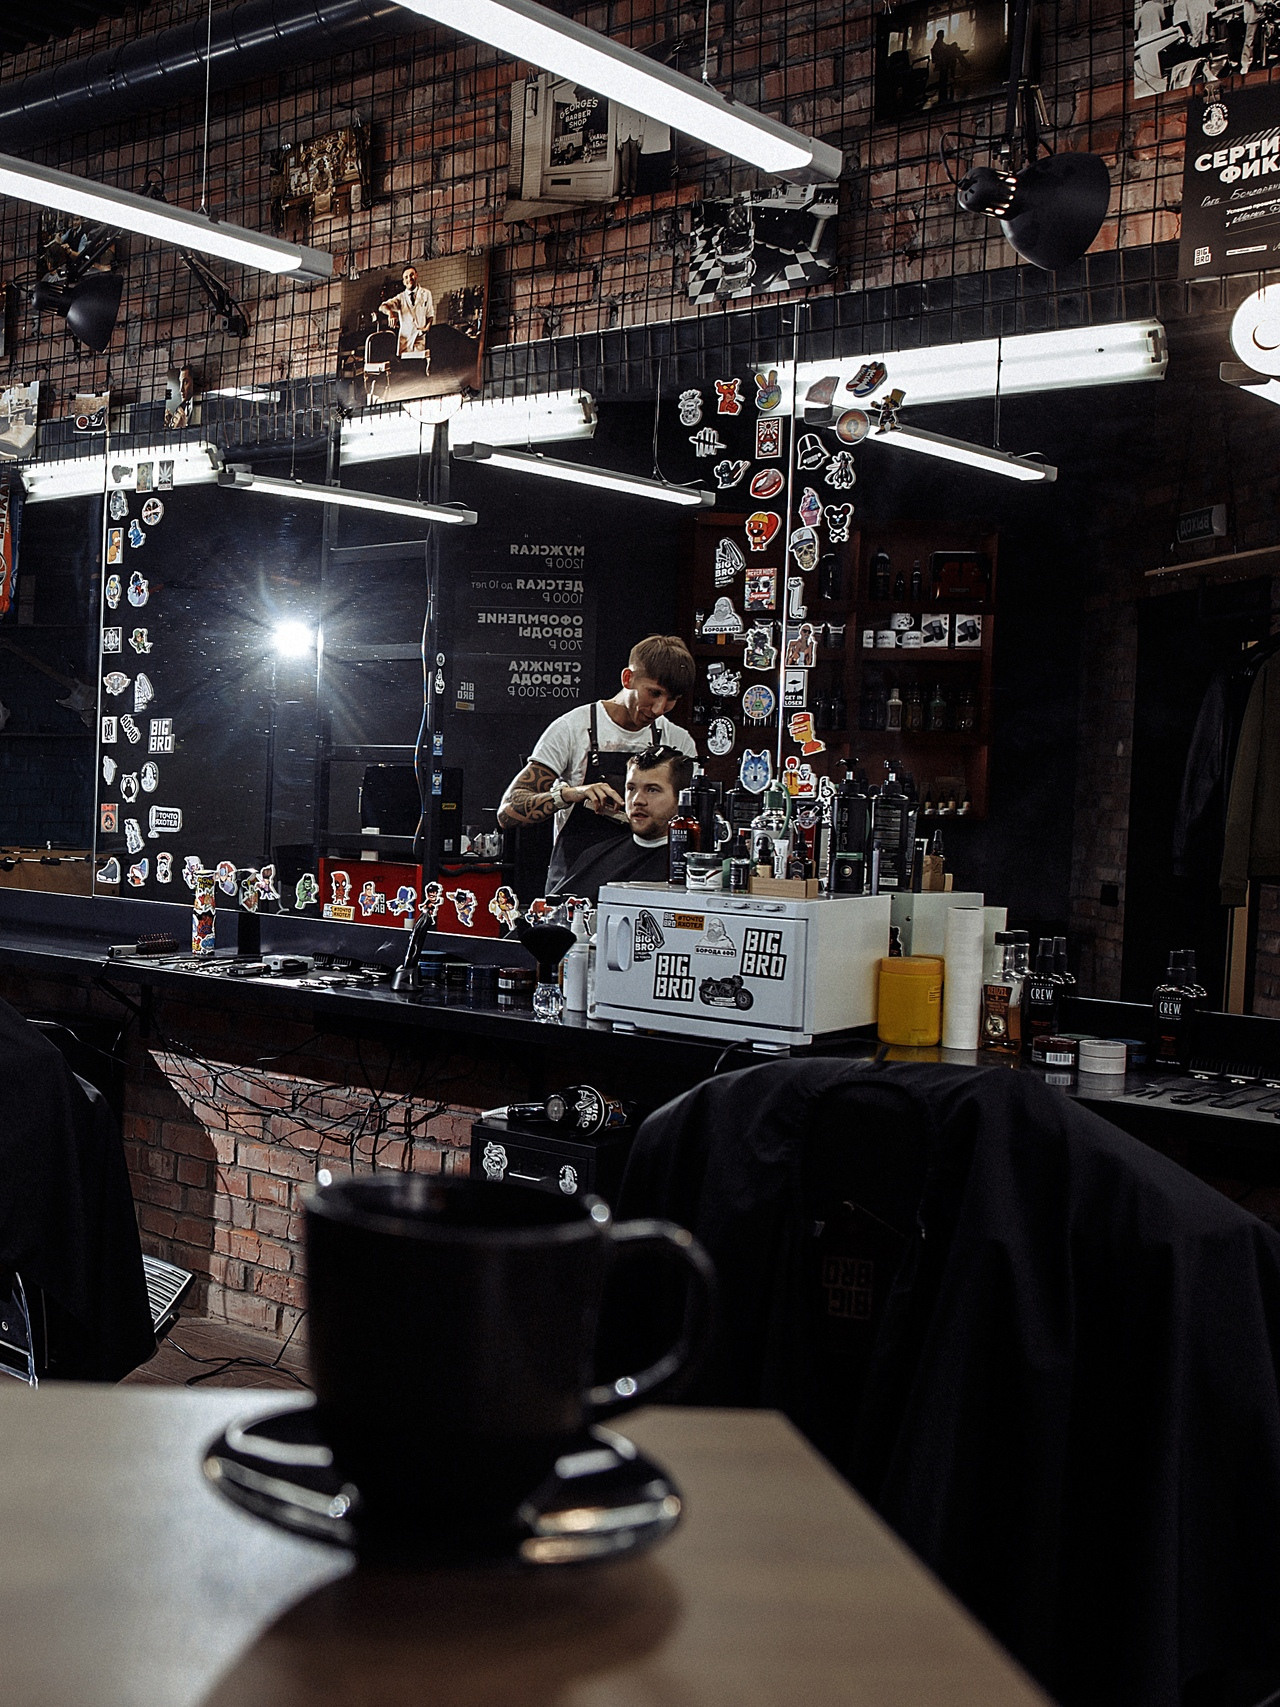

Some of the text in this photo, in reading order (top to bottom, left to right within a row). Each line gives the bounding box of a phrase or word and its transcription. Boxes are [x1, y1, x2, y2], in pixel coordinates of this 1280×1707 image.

[560, 97, 599, 119] GEORGE'S
[565, 109, 592, 122] BARBER
[568, 118, 587, 128] SHOP
[1220, 154, 1280, 184] ФИК
[1196, 247, 1209, 257] BIG
[1196, 255, 1210, 264] BRO
[716, 561, 732, 569] BIG
[715, 568, 734, 577] BRO
[152, 720, 170, 736] BIG
[150, 736, 172, 752] BRO
[635, 935, 652, 943] BIG
[746, 930, 780, 954] BIG
[635, 943, 654, 951] BRO
[696, 947, 722, 955] БОРОДА
[658, 955, 688, 977] BIG
[742, 952, 785, 978] BRO
[656, 976, 694, 1000] BRO
[1030, 987, 1054, 1000] CREW
[1160, 1002, 1182, 1015] CREW
